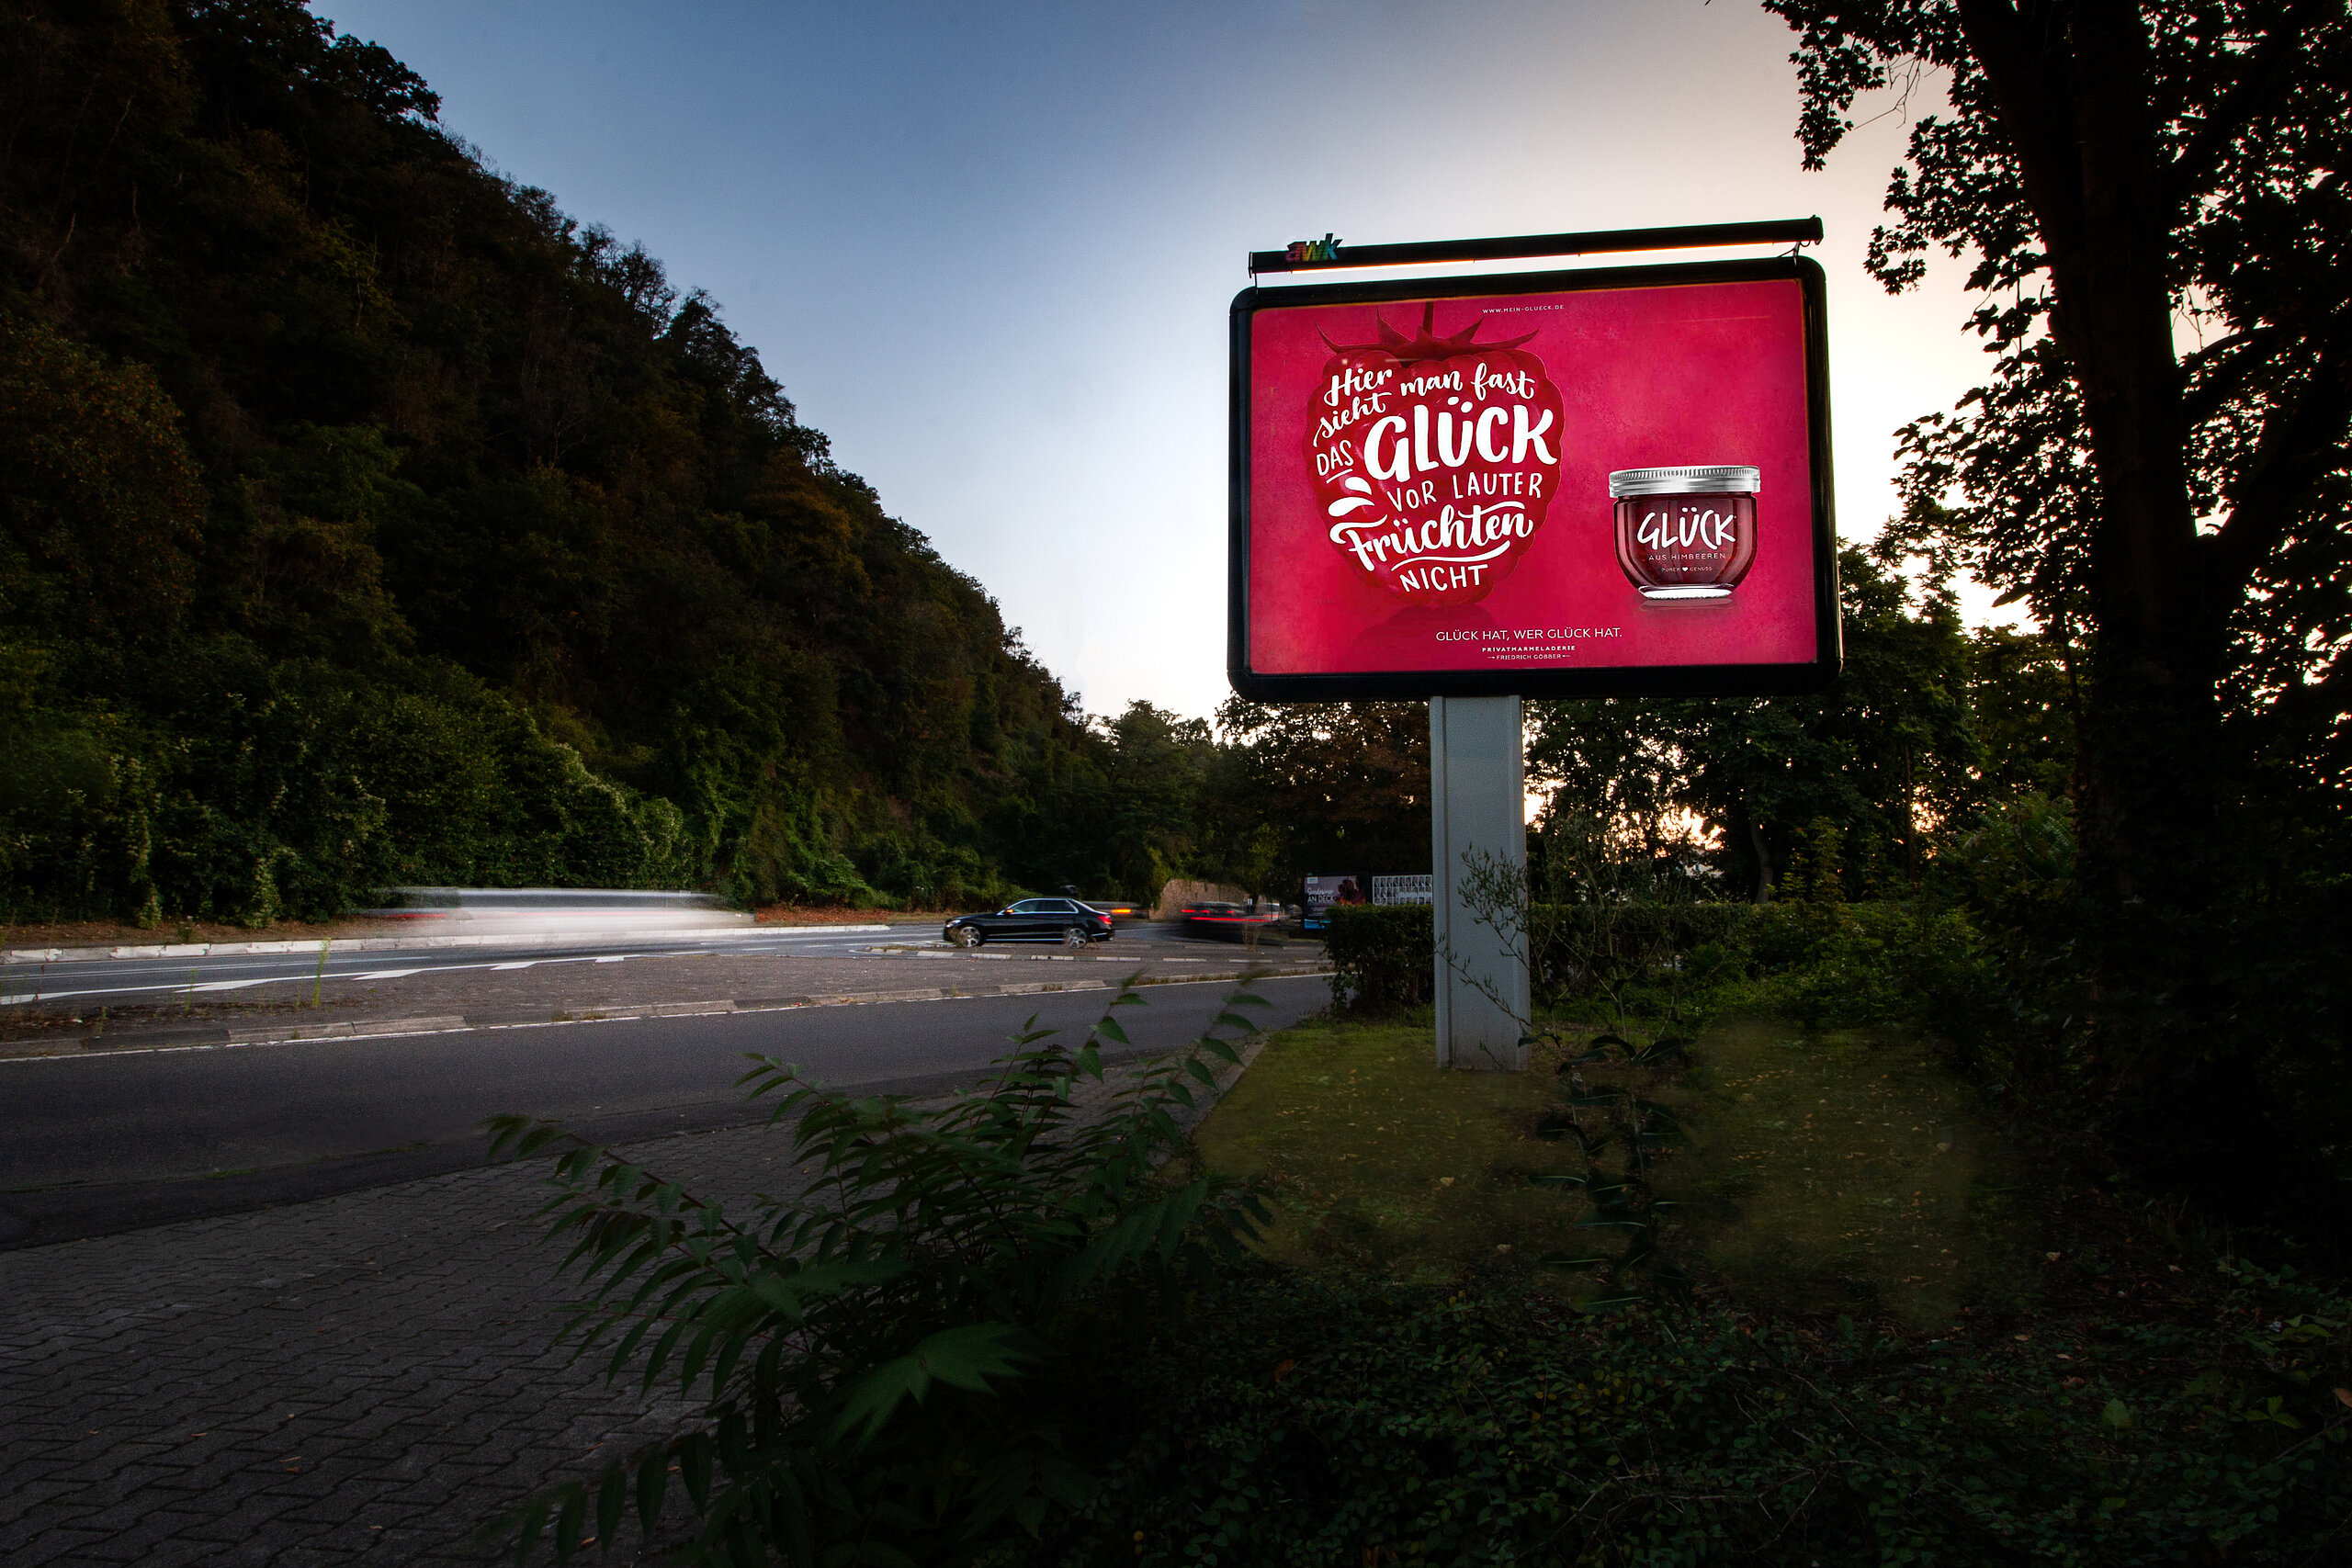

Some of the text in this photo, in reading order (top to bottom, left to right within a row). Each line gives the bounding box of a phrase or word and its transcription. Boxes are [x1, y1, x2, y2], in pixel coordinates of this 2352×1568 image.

[1285, 232, 1343, 262] awk
[1482, 305, 1565, 314] WWW.MEIN-GLUECK.DE
[1324, 363, 1535, 406] Hier man fast
[1313, 392, 1393, 447] sieht
[1316, 396, 1558, 482] DAS GLÜCK
[1387, 471, 1543, 512] VOR LAUTER
[1329, 501, 1534, 571] Früchten
[1637, 507, 1736, 550] GLÜCK
[1399, 564, 1488, 592] NICHT
[1435, 627, 1623, 641] GLÜCK HAT, WER GLÜCK HAT.
